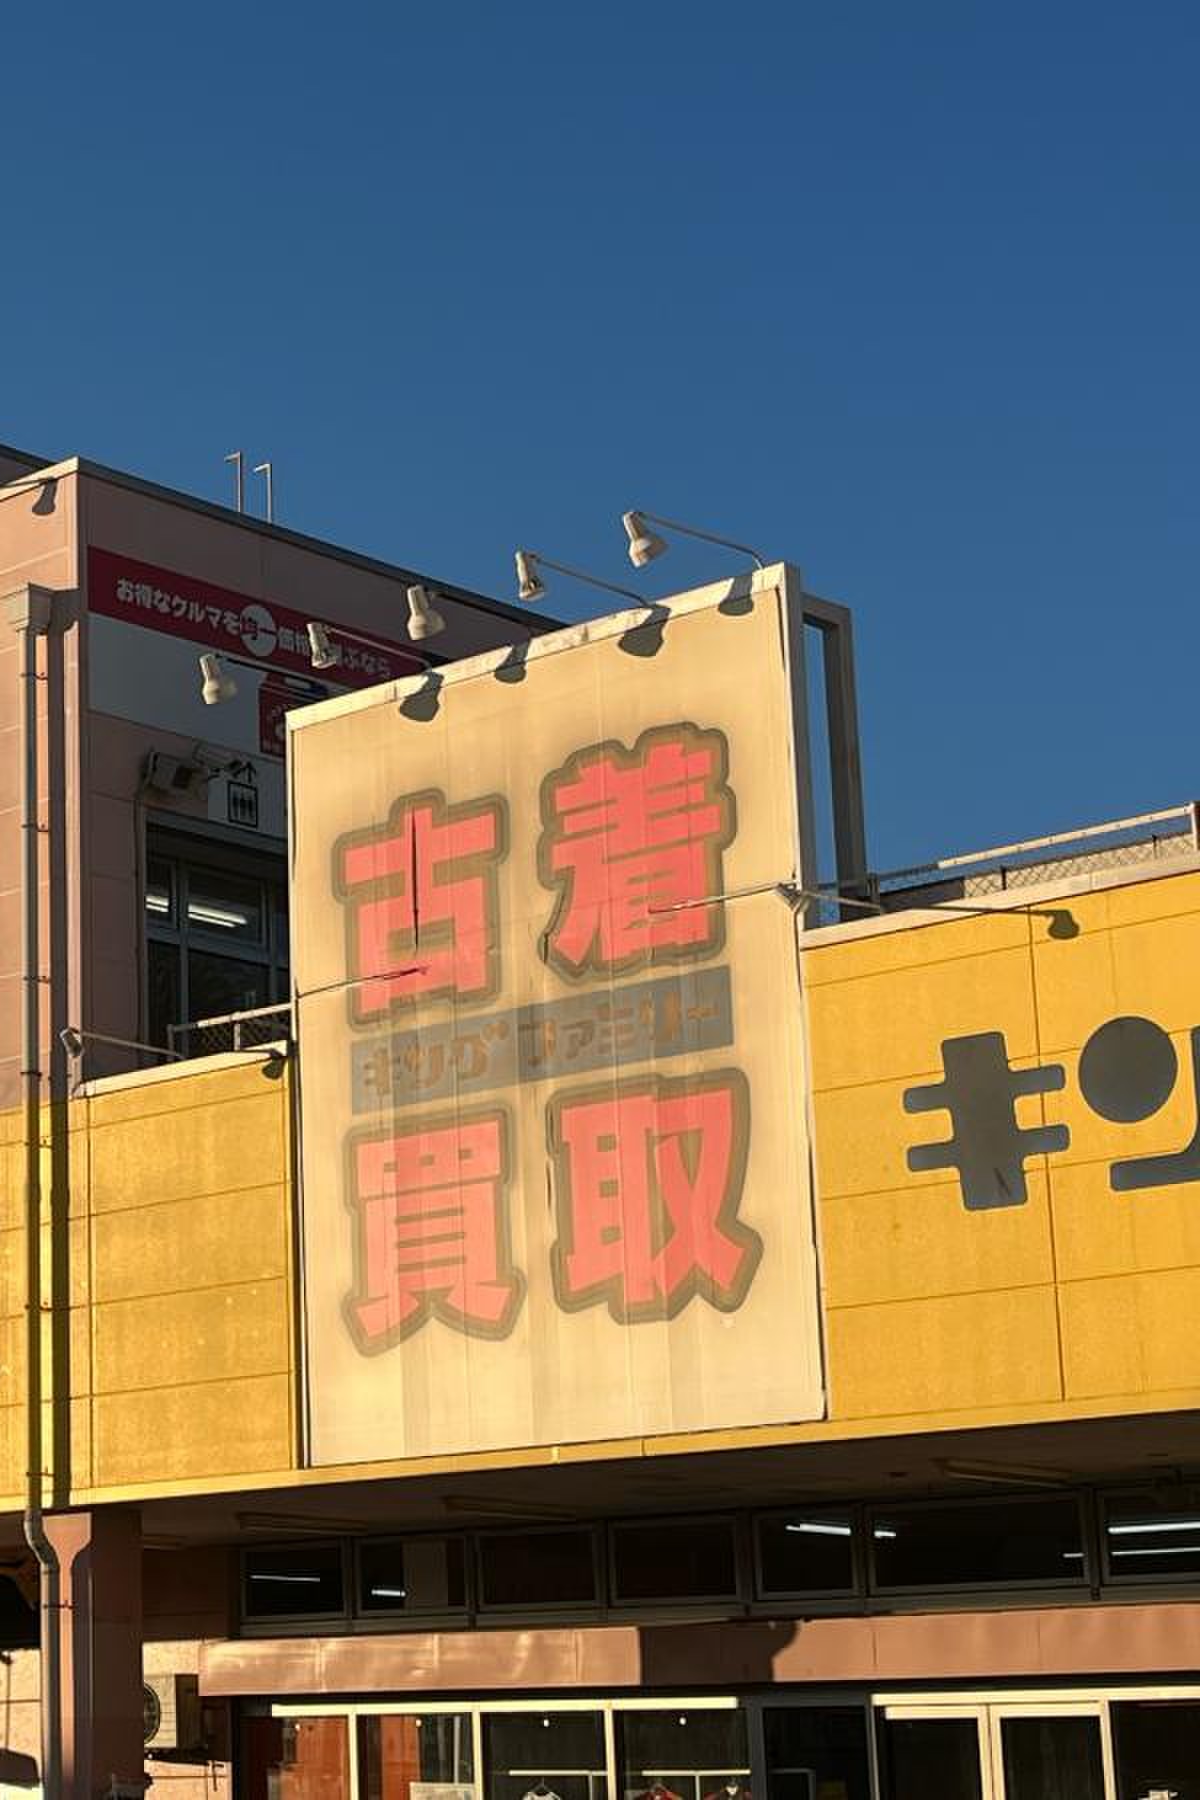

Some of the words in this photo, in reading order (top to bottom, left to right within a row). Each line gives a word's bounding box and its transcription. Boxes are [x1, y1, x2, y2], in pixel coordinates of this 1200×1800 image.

[116, 577, 242, 636] お得なクルマを
[332, 722, 737, 1029] 古着
[341, 1067, 763, 1359] 買取
